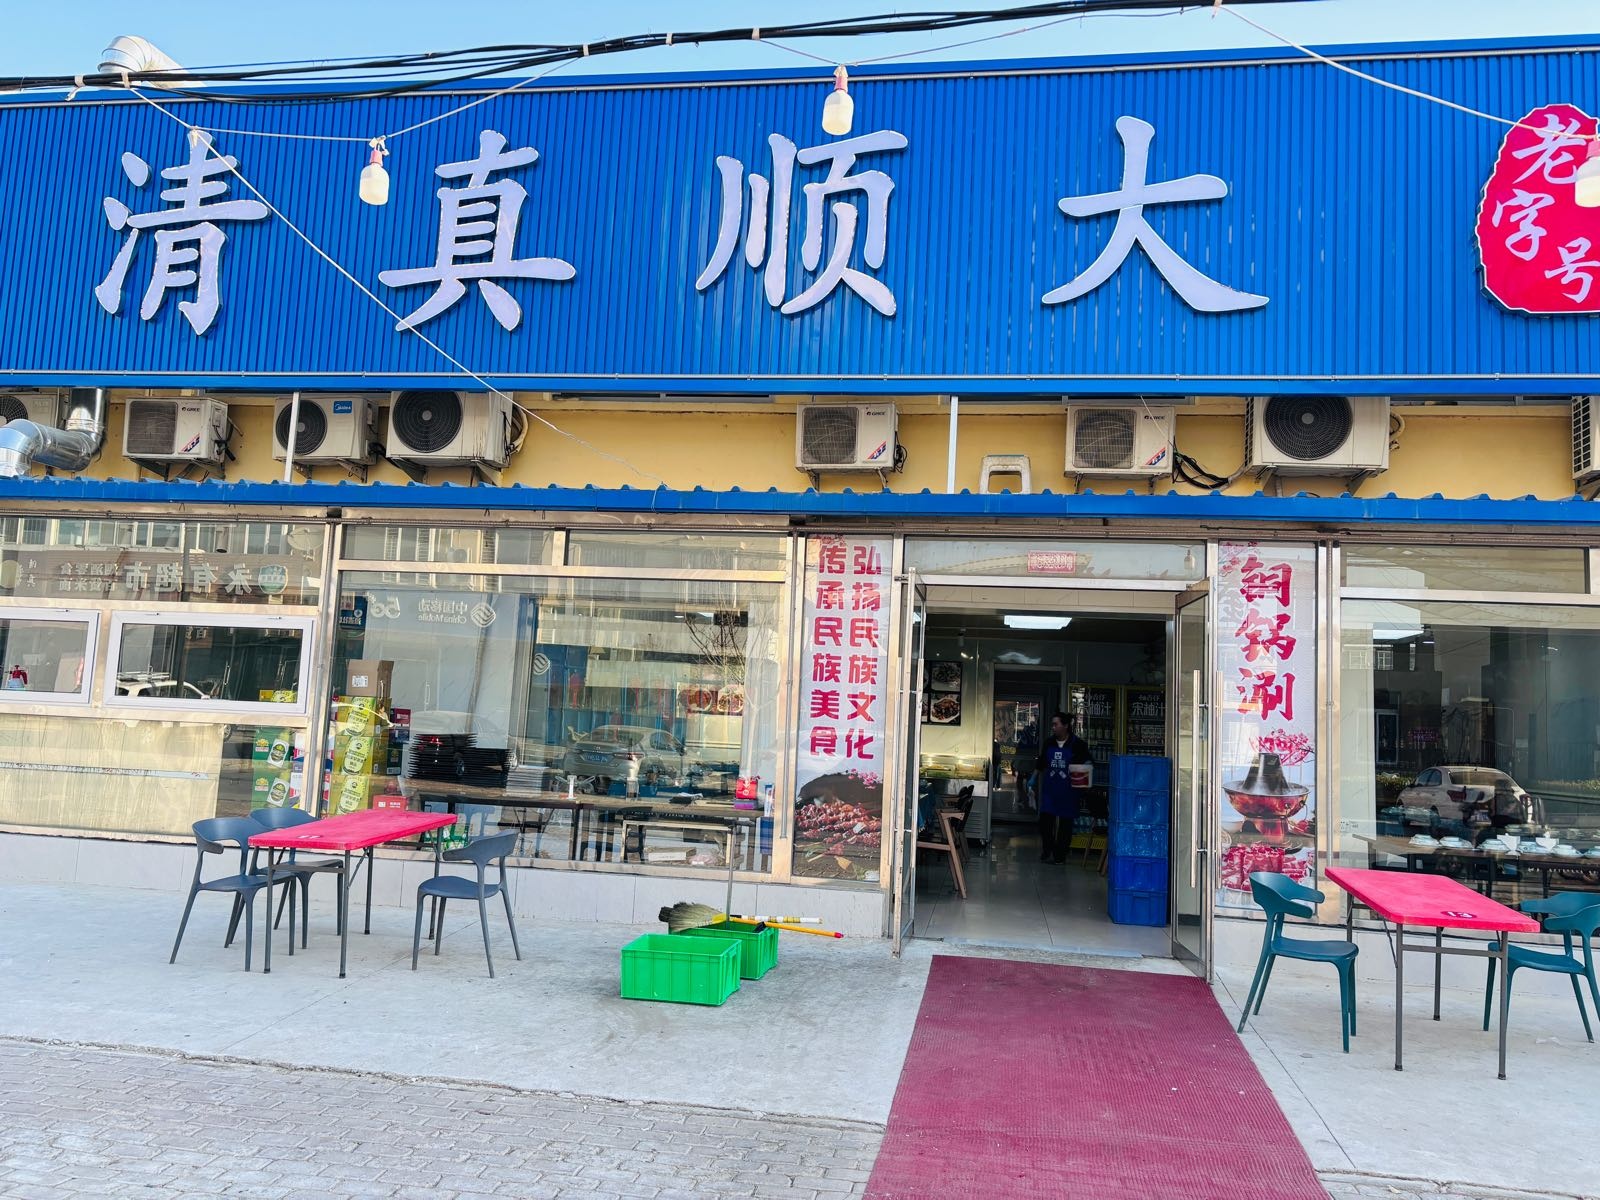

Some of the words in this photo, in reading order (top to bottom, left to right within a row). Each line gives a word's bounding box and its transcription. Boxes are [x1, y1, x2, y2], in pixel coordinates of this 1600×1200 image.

[1491, 113, 1600, 304] 老字号
[809, 545, 847, 758] 传承民族美食
[845, 545, 882, 760] 弘扬民族文化
